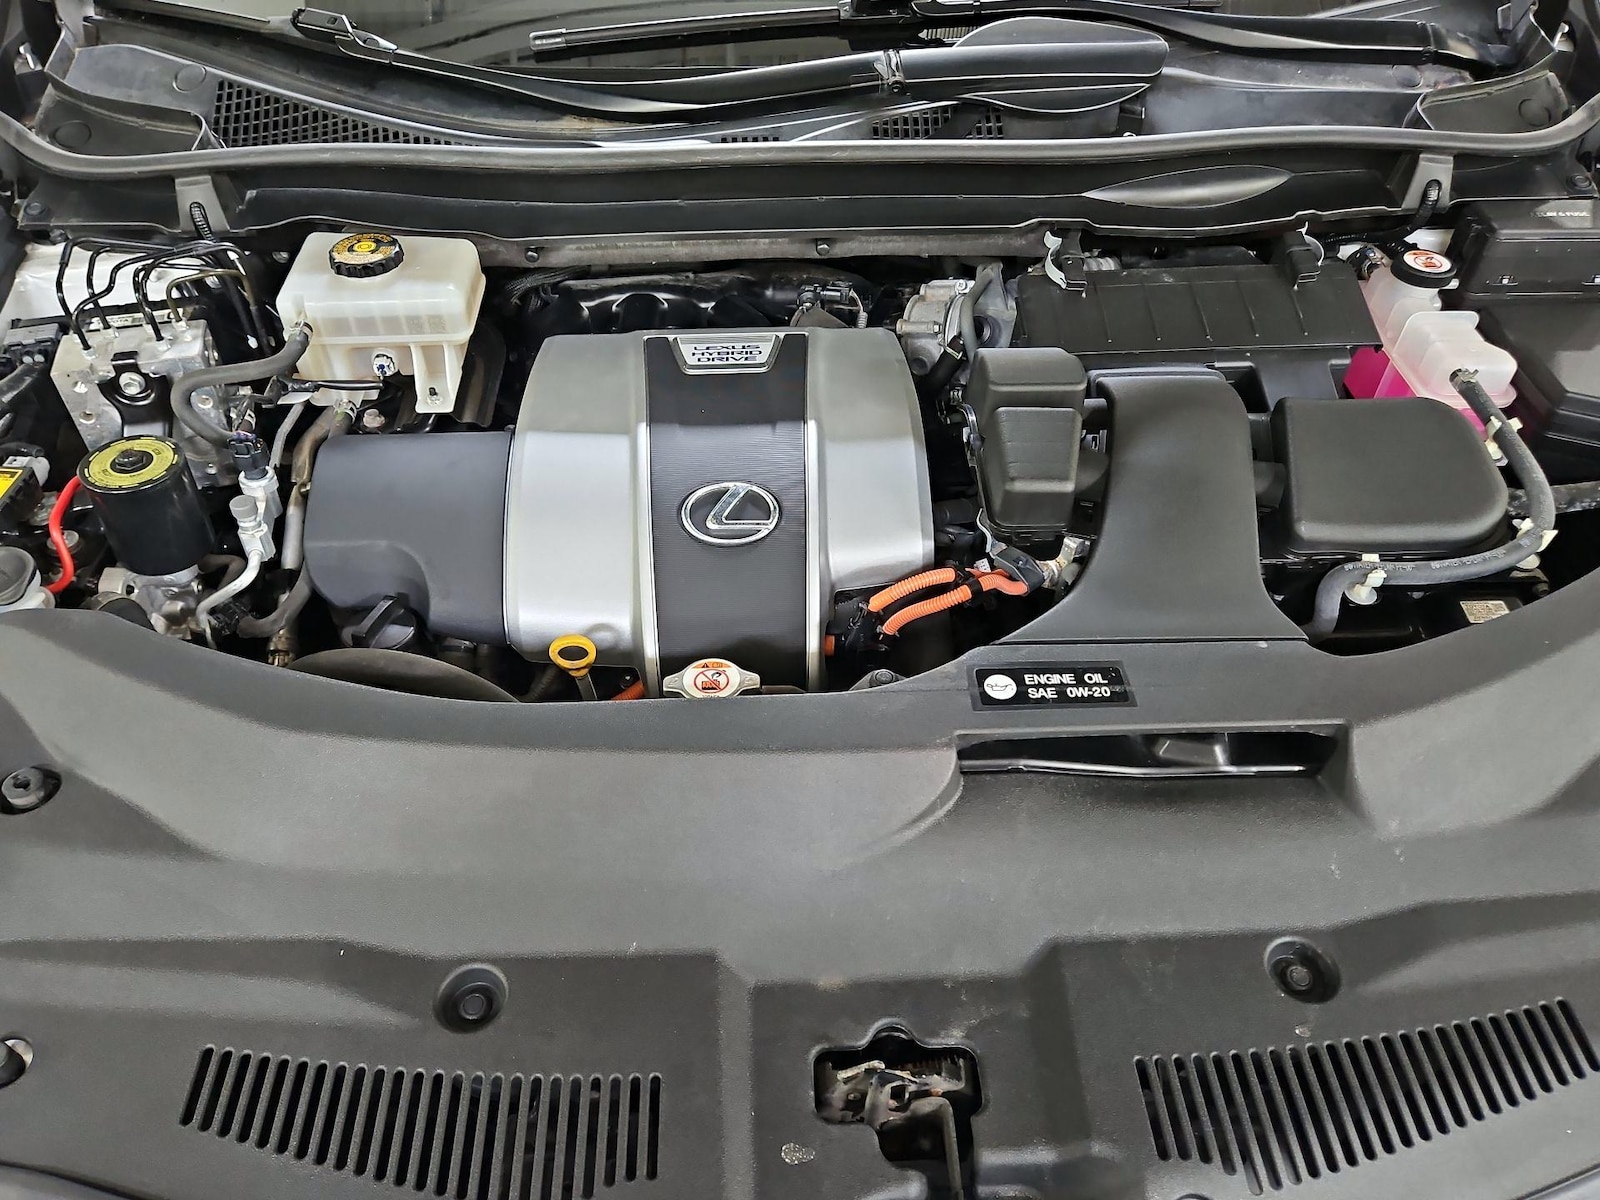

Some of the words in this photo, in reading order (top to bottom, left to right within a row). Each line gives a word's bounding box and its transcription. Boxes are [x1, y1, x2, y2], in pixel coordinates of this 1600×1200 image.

[1024, 673, 1076, 685] ENGINE
[1083, 673, 1109, 684] OIL
[1027, 687, 1058, 699] SAE
[1066, 686, 1111, 698] 0W-20
